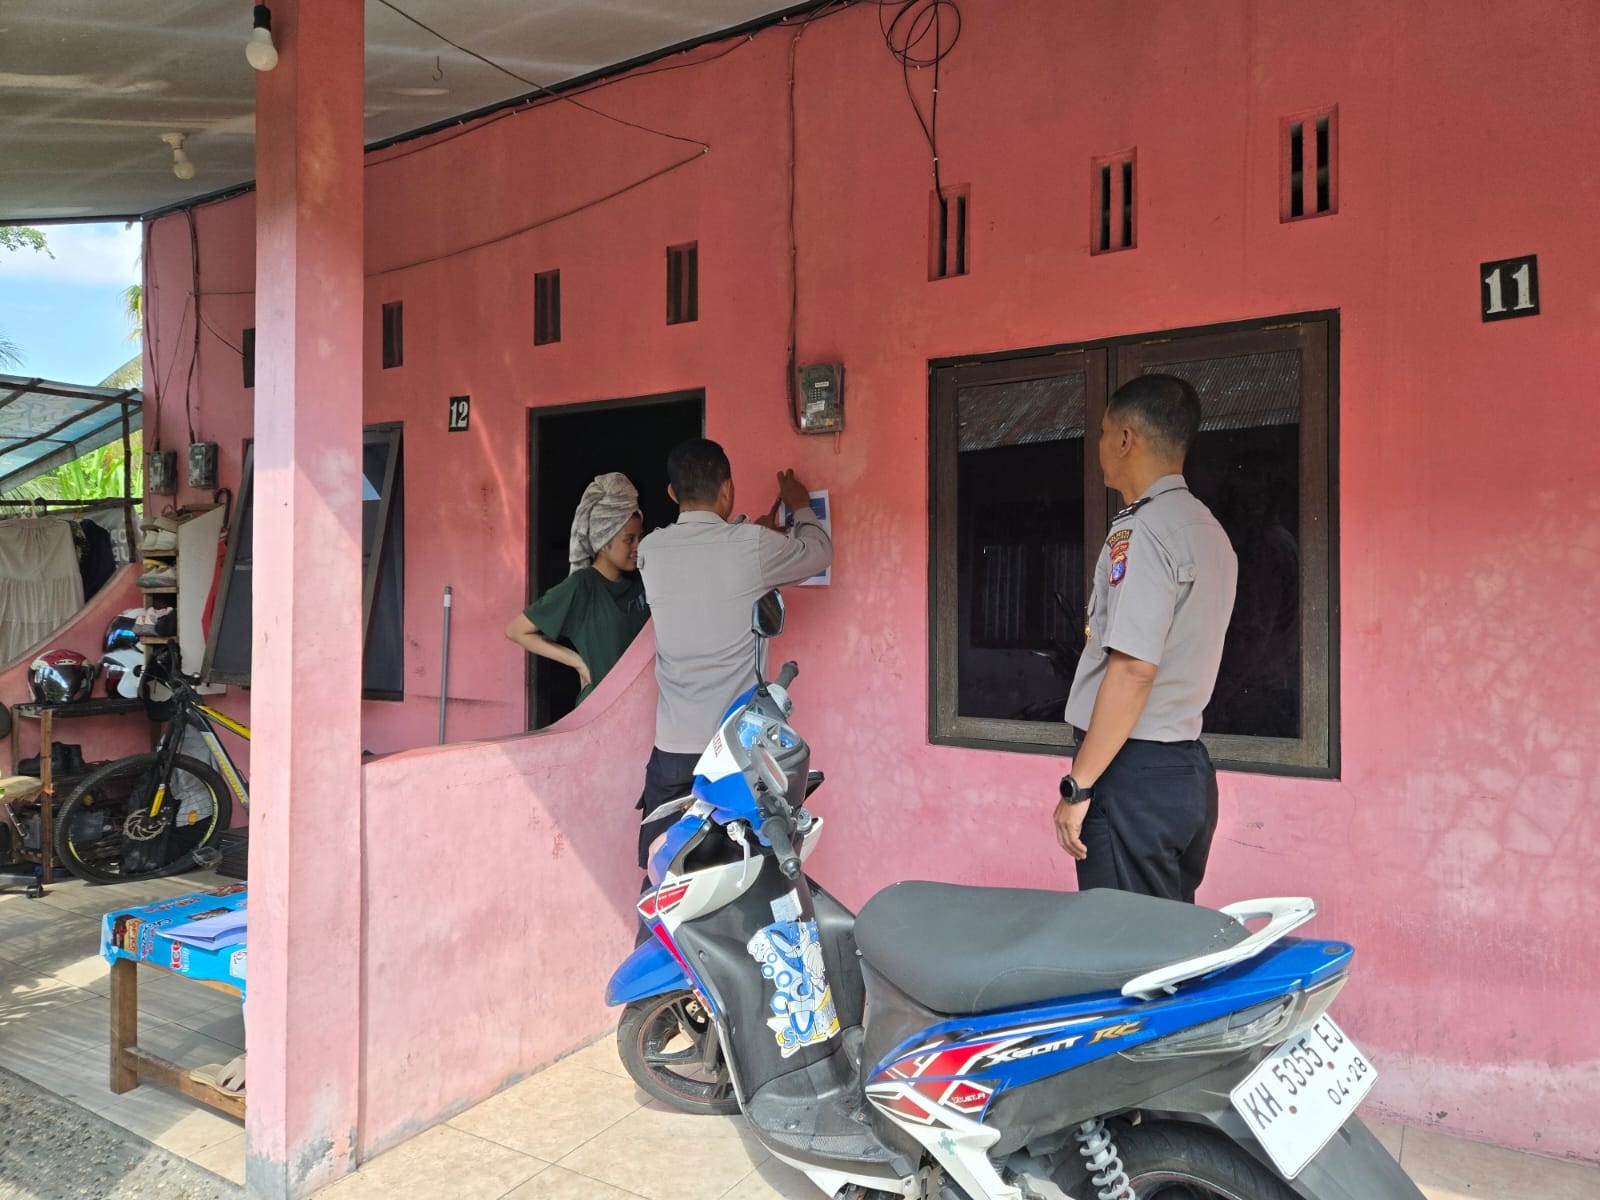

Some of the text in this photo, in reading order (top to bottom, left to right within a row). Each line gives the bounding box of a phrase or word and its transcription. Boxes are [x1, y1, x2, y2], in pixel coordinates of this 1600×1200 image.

[1485, 264, 1535, 314] 11
[450, 401, 468, 427] 12
[1243, 1015, 1344, 1130] KH 5355 EJ
